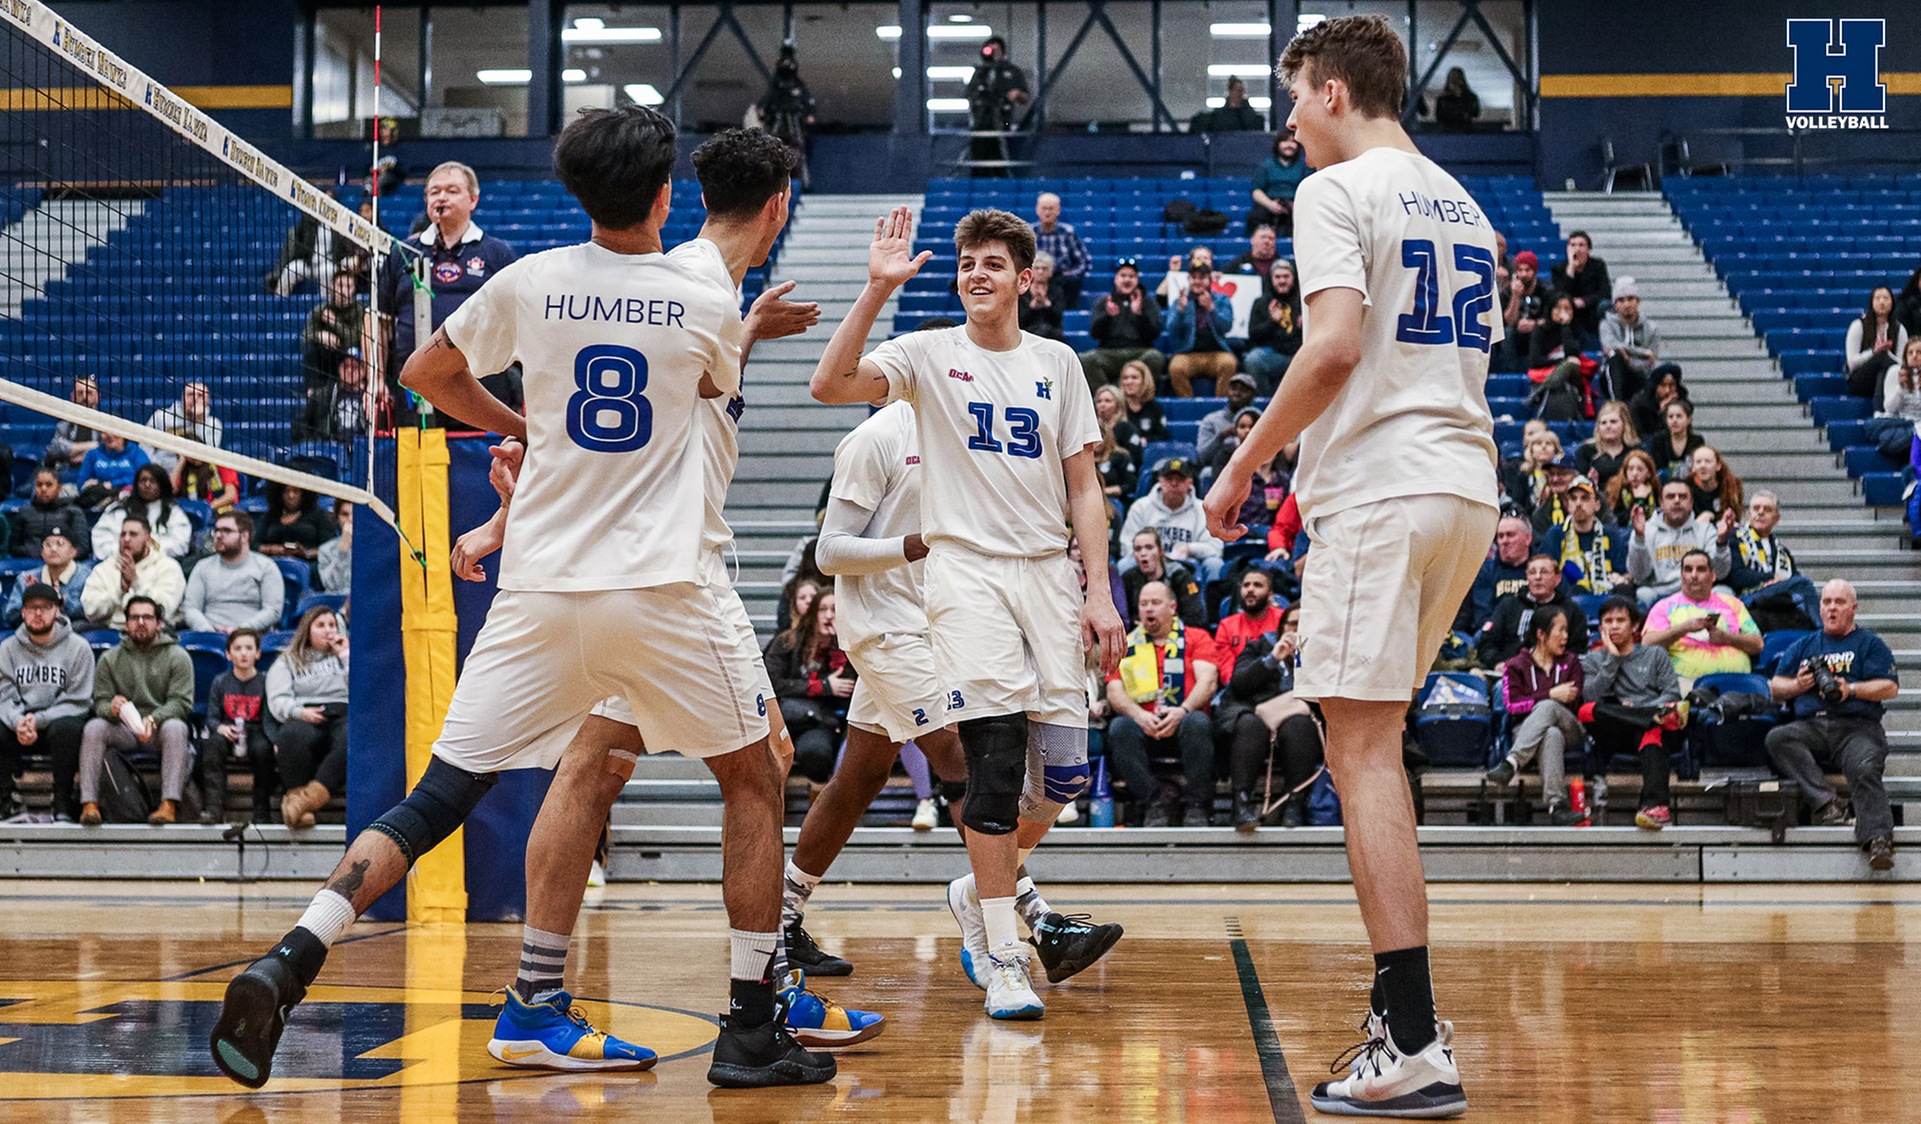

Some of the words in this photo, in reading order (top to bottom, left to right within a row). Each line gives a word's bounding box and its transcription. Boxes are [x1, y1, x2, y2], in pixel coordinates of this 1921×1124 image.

[1399, 190, 1486, 230] HUMBER
[544, 294, 686, 329] HUMBER
[1396, 239, 1495, 354] 12
[566, 343, 653, 453] 8
[967, 401, 1043, 459] 13
[757, 693, 767, 717] 8
[912, 708, 929, 727] 2
